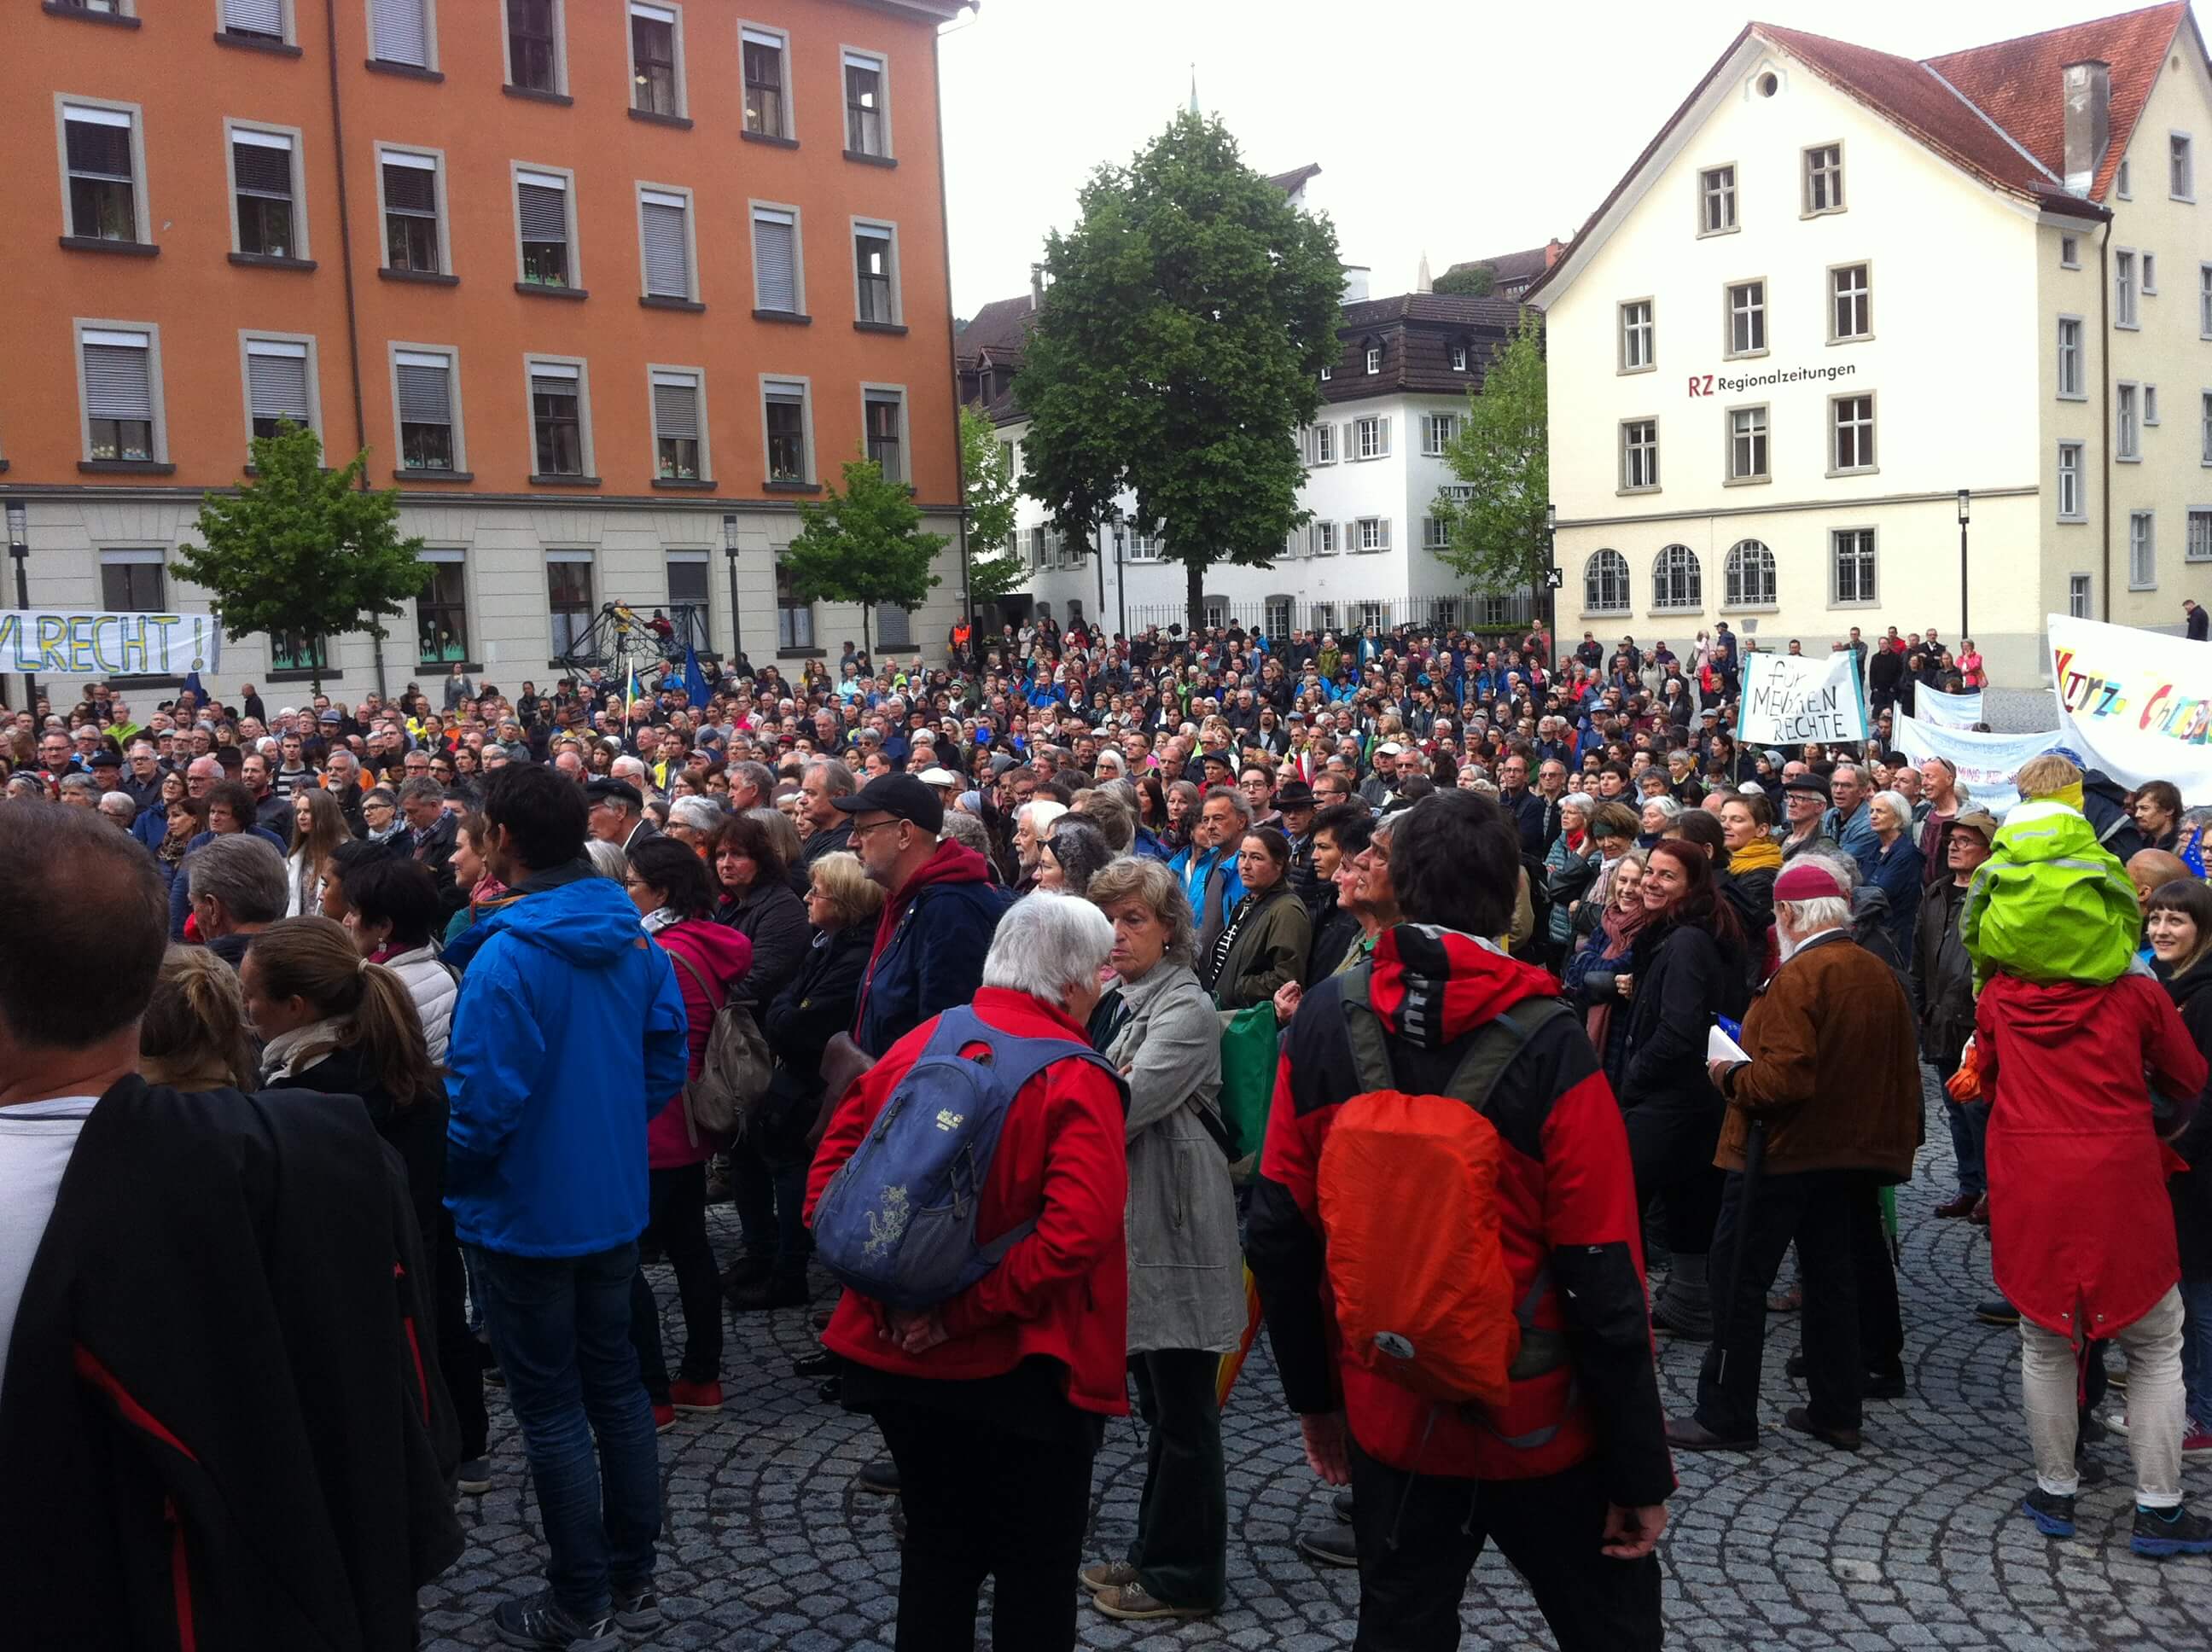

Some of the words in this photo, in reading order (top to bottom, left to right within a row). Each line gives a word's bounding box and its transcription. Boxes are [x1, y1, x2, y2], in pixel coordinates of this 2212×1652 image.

[1689, 375, 1714, 397] RZ
[1718, 364, 1855, 392] Regionalzeitungen
[1772, 714, 1848, 742] RECHTE
